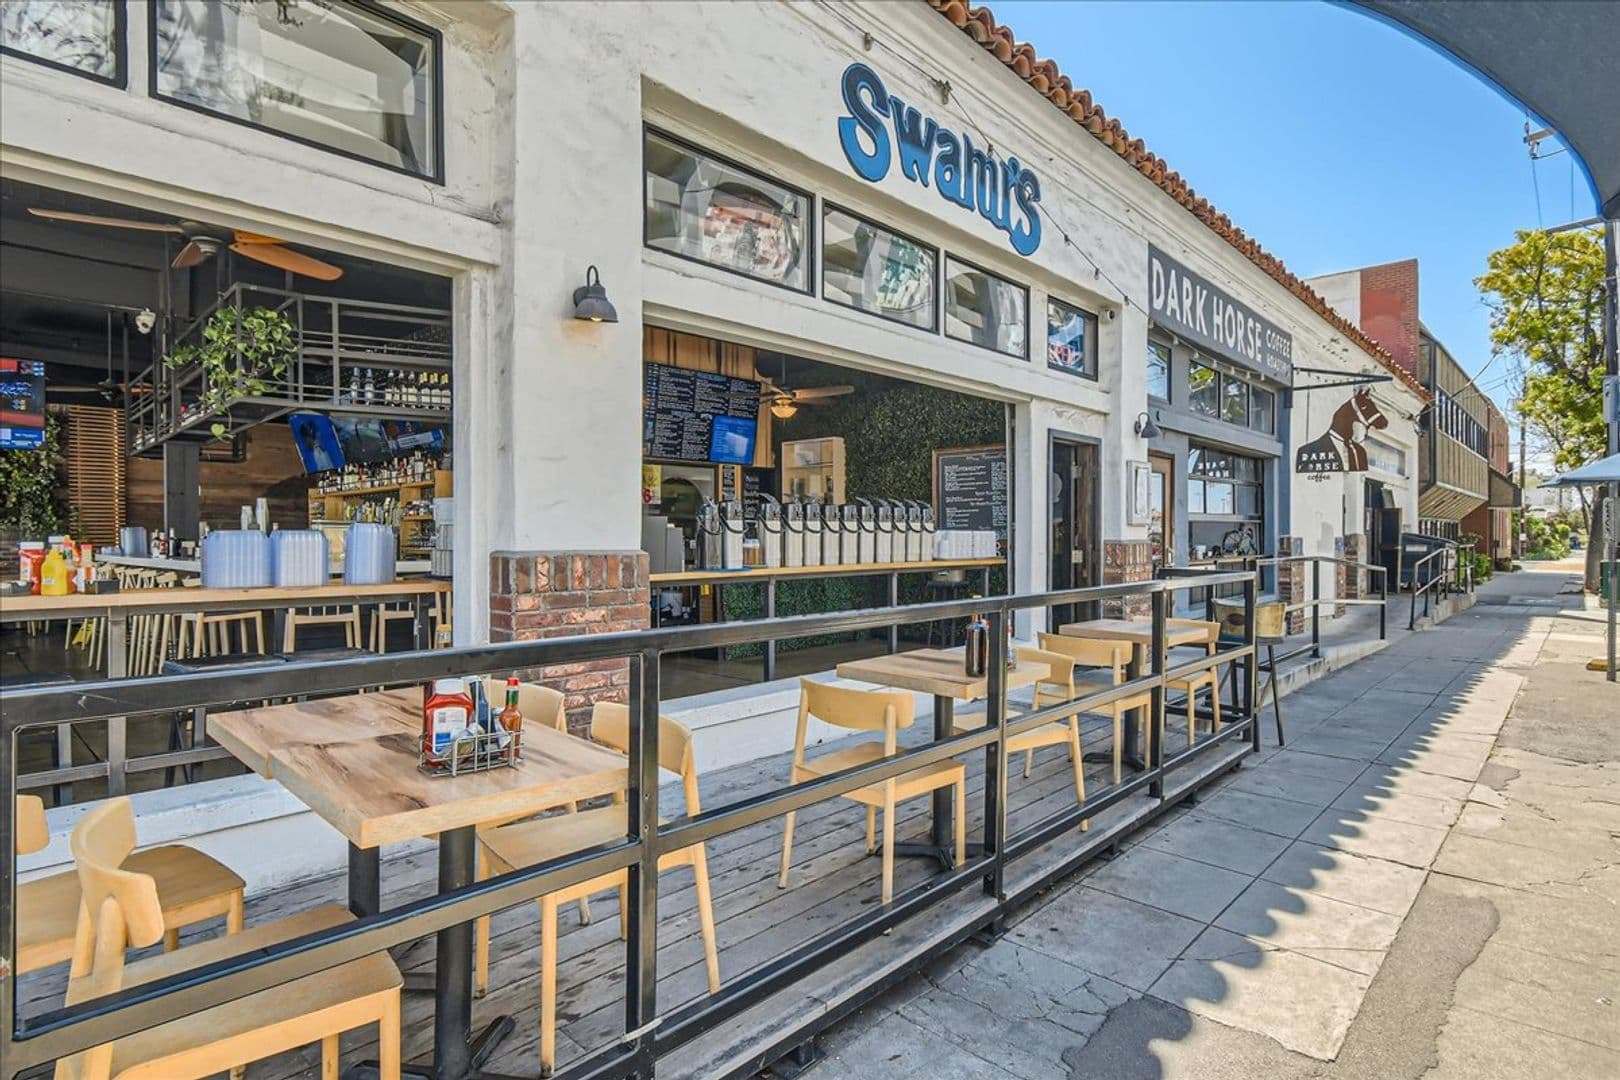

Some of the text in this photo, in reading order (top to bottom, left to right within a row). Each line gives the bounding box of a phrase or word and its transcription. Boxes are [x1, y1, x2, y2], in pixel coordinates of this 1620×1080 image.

[1152, 257, 1262, 363] DARK HORSE
[1266, 329, 1291, 359] COFFEE
[1301, 451, 1336, 462] DARK
